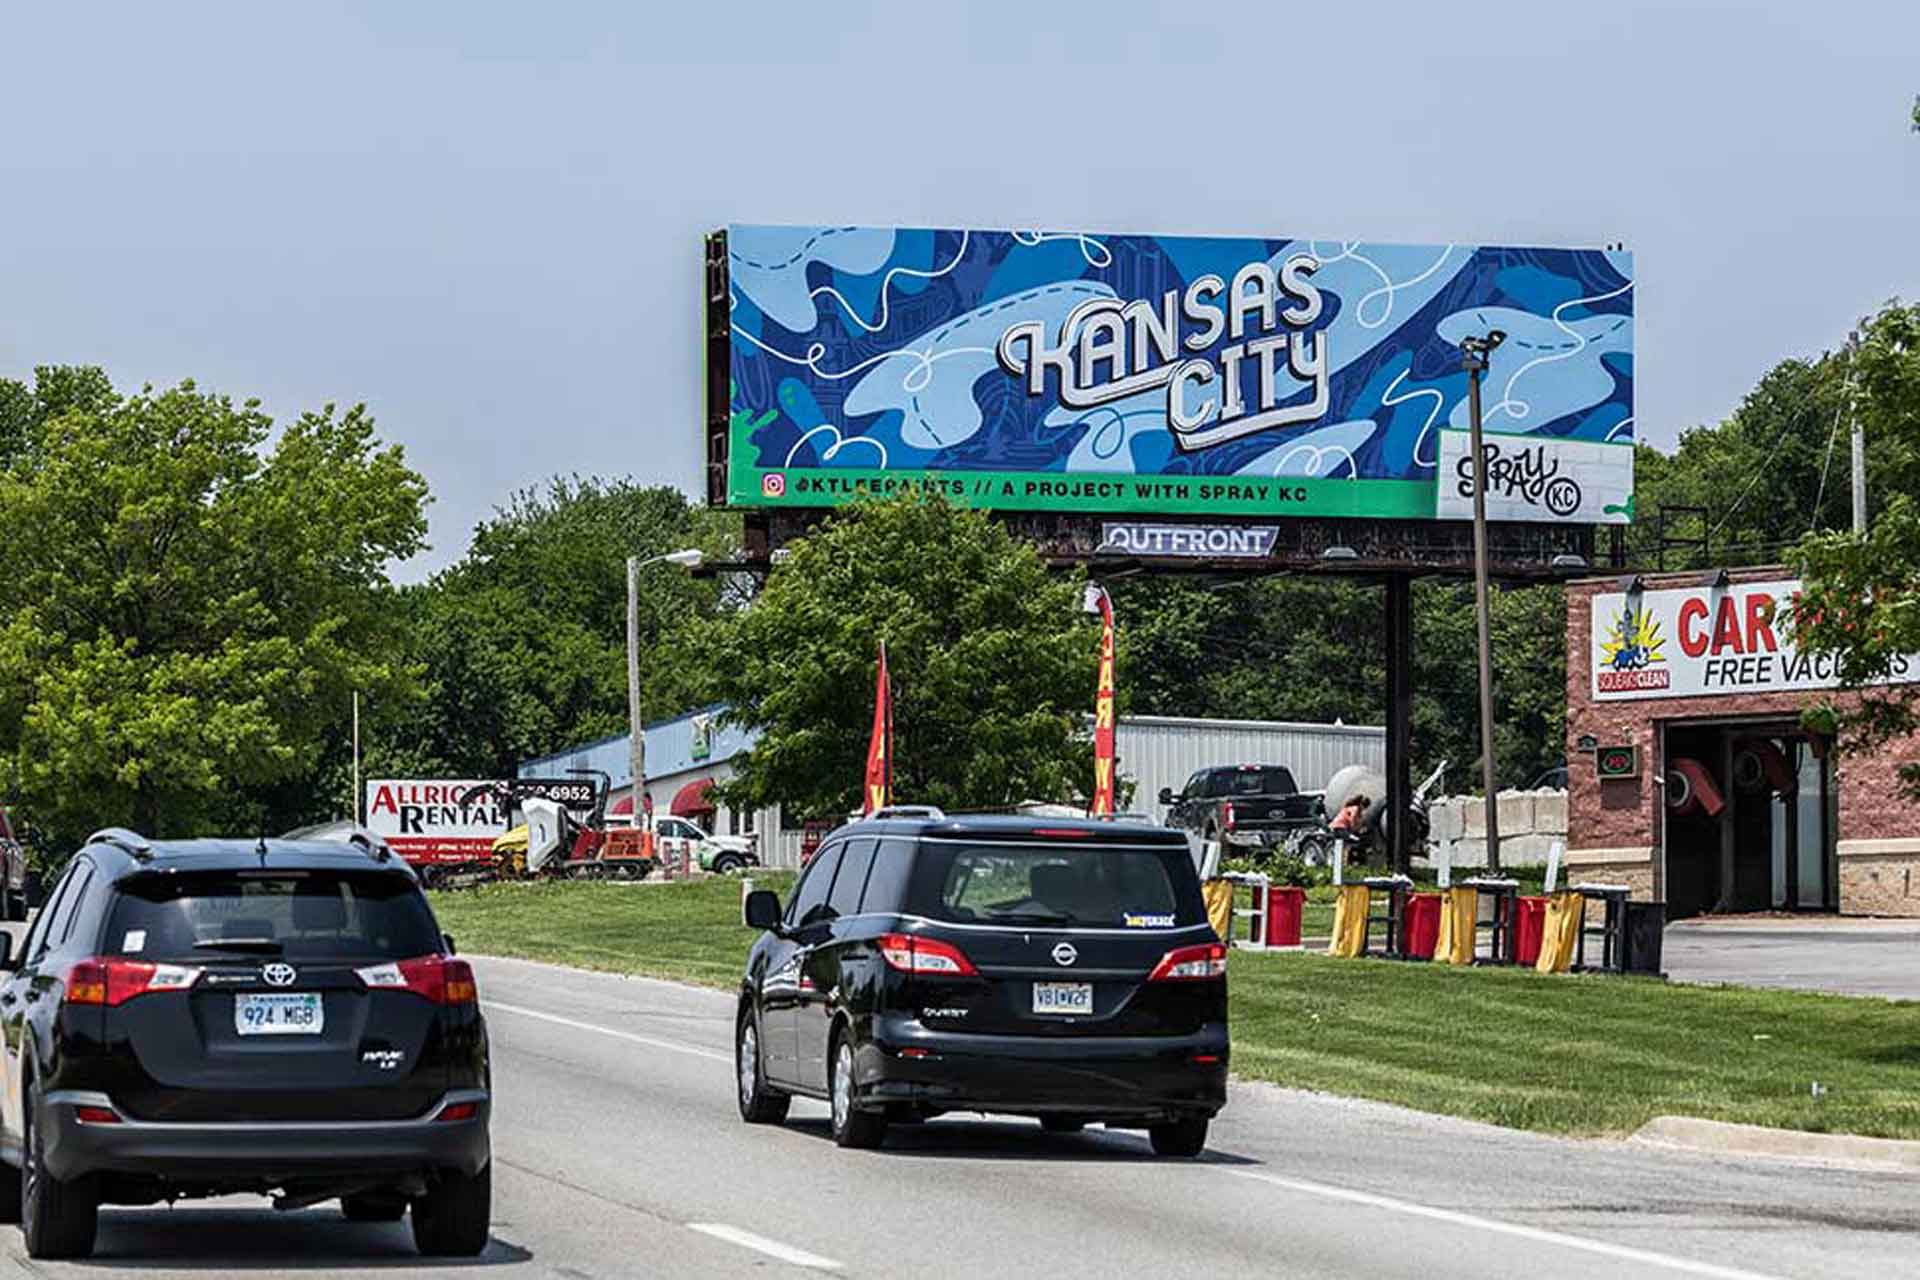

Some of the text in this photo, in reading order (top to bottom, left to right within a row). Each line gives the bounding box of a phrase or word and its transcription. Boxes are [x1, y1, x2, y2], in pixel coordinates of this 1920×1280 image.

[998, 254, 1323, 410] KANSAS
[1167, 330, 1330, 451] CITY
[1002, 482, 1015, 497] A
[1025, 482, 1125, 498] PROJECT
[1135, 484, 1189, 499] WITH
[1199, 485, 1269, 500] SPRAY
[1279, 487, 1307, 501] KC
[1552, 487, 1574, 508] KC
[1108, 527, 1269, 552] OUTFRONT
[1678, 593, 1778, 658] CAR
[1704, 650, 1910, 686] FREE VACS
[371, 785, 500, 815] ALLRIG
[400, 806, 503, 834] RENTAL
[244, 1006, 274, 1025] 924
